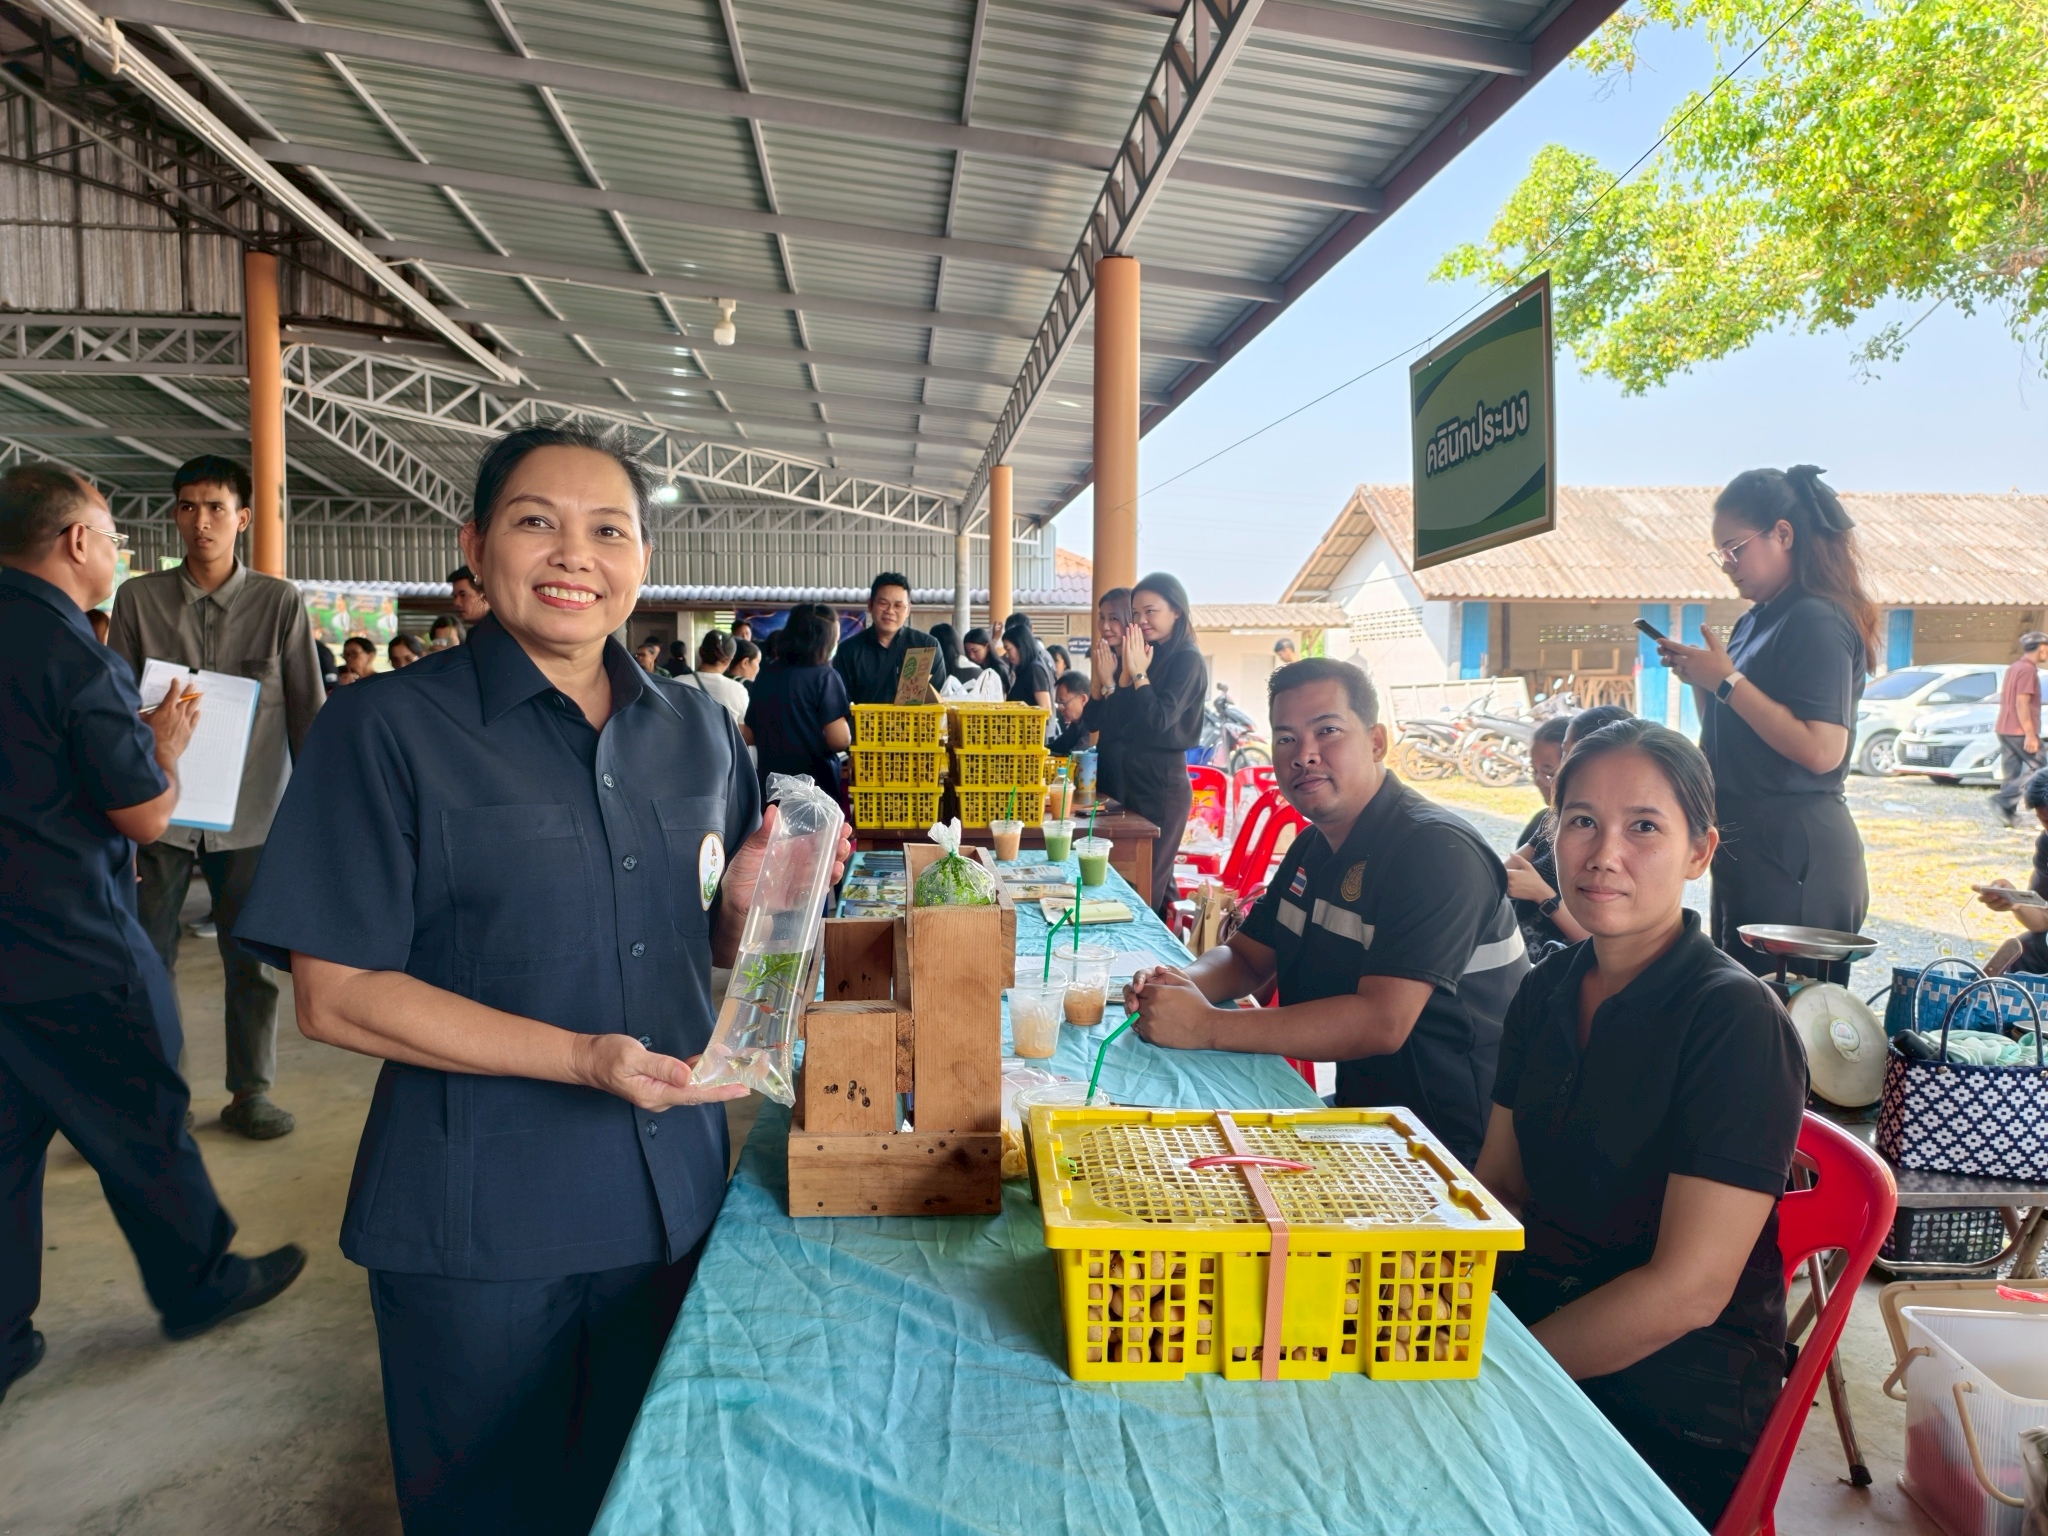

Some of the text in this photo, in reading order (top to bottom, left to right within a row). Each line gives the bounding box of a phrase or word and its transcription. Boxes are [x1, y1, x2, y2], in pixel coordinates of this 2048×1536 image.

[1427, 393, 1529, 475] คลินิกประมง
